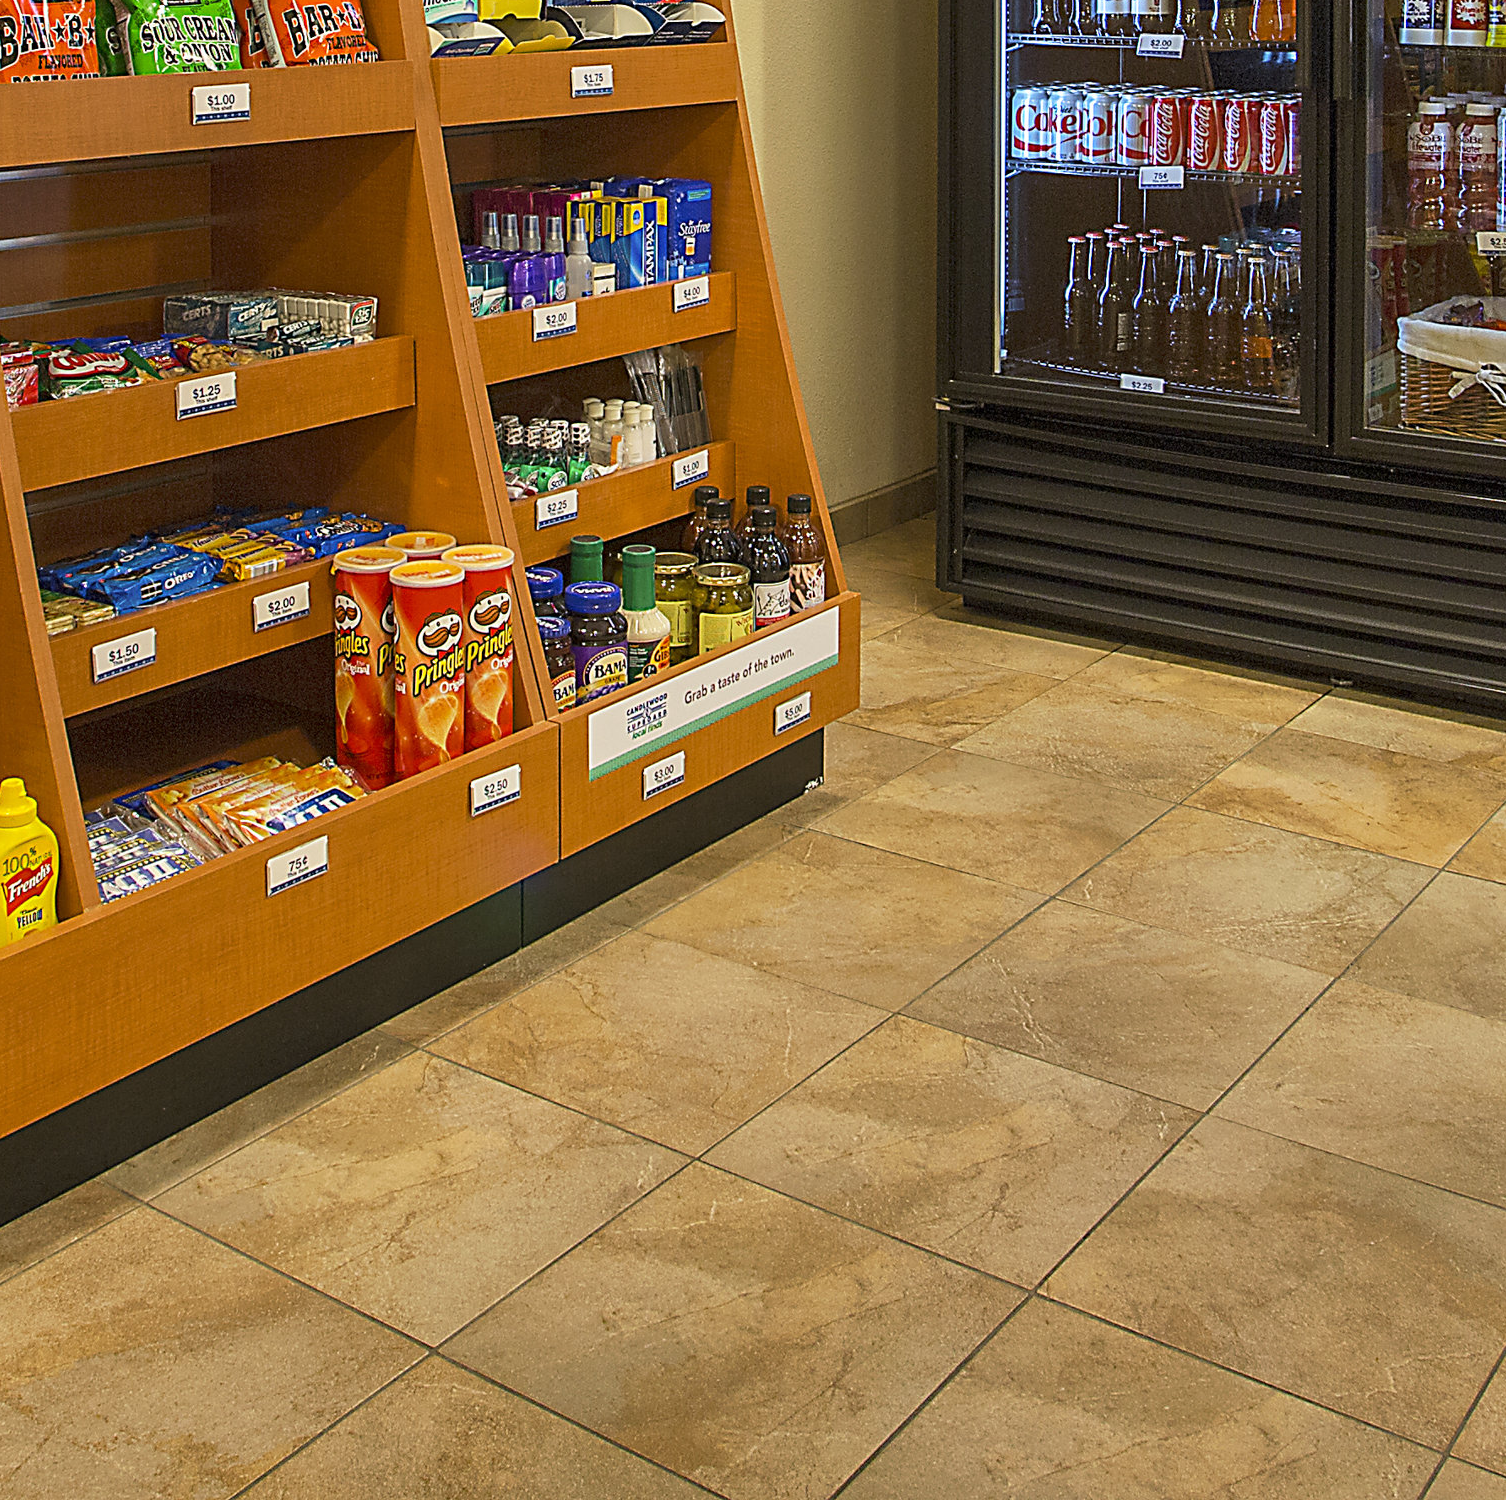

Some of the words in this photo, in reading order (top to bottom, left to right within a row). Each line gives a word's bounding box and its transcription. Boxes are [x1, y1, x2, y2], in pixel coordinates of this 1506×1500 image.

[583, 72, 604, 84] $1.75
[207, 92, 236, 107] $1.00
[643, 219, 656, 286] TAMPAX
[546, 312, 568, 325] $2.00
[191, 383, 222, 399] $1.25
[267, 595, 296, 612] $2.00
[108, 643, 140, 661] $1.50
[594, 656, 627, 677] BAMA
[684, 684, 708, 705] Grab
[710, 684, 716, 693] a
[717, 673, 740, 691] taste
[742, 664, 753, 680] of
[754, 659, 769, 675] the
[770, 648, 795, 669] town.
[483, 777, 509, 795] $2.50
